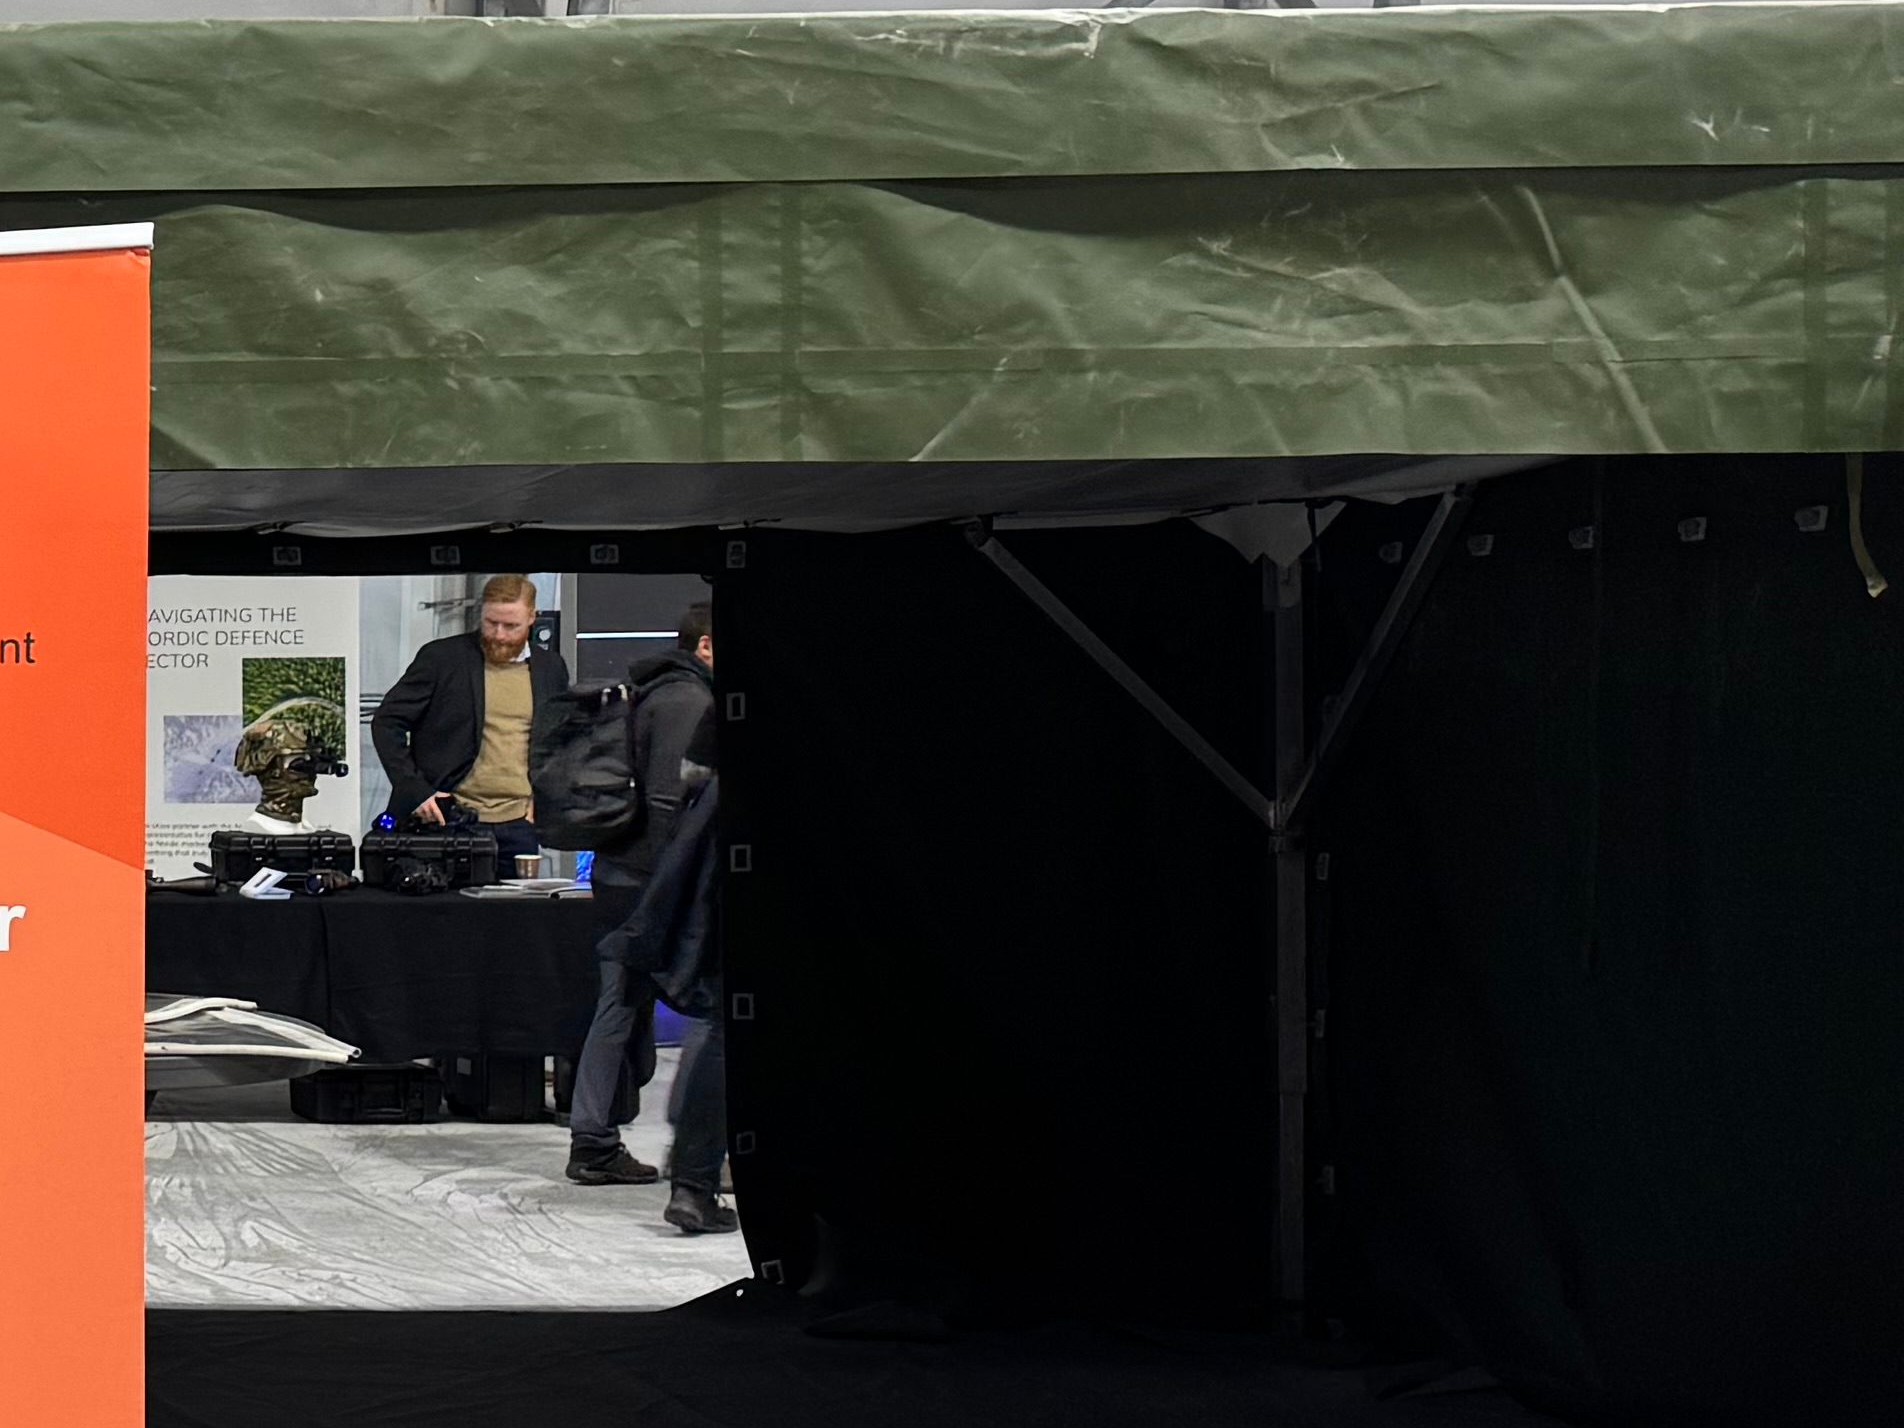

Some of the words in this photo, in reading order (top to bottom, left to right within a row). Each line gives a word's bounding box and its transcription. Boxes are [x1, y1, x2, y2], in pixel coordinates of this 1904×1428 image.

[147, 607, 253, 624] AVIGATING
[257, 606, 298, 623] THE
[147, 630, 210, 647] ORDIC
[214, 628, 305, 646] DEFENCE
[145, 653, 210, 669] ECTOR
